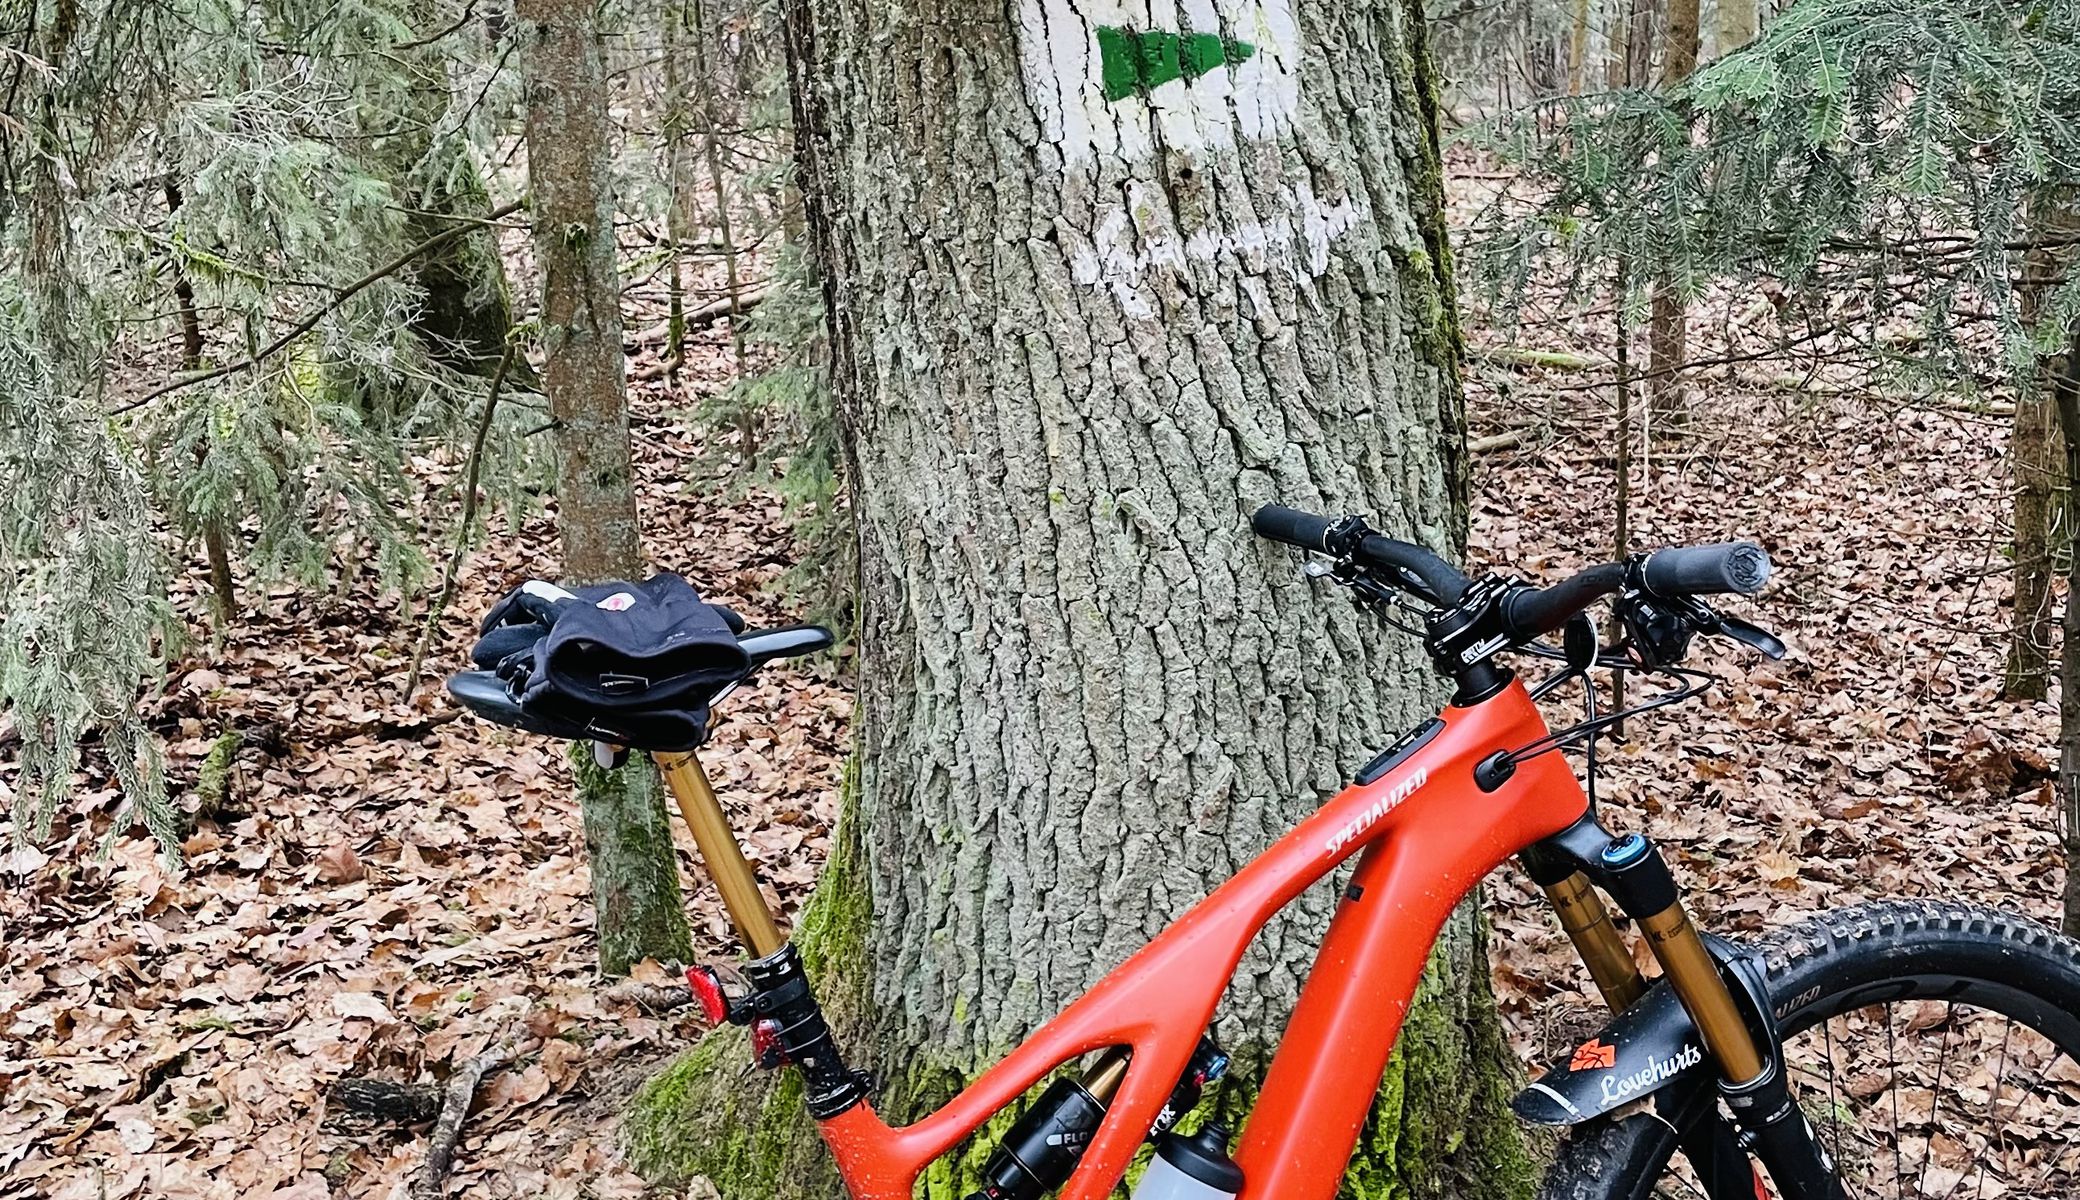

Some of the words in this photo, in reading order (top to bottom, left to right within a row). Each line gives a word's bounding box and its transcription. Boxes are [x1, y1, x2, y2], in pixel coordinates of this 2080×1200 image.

[1325, 767, 1428, 859] SPECIALIZED
[1775, 984, 1821, 1018] ALIZED
[1600, 1043, 1702, 1105] Lovehurts
[1063, 1131, 1088, 1144] FLO
